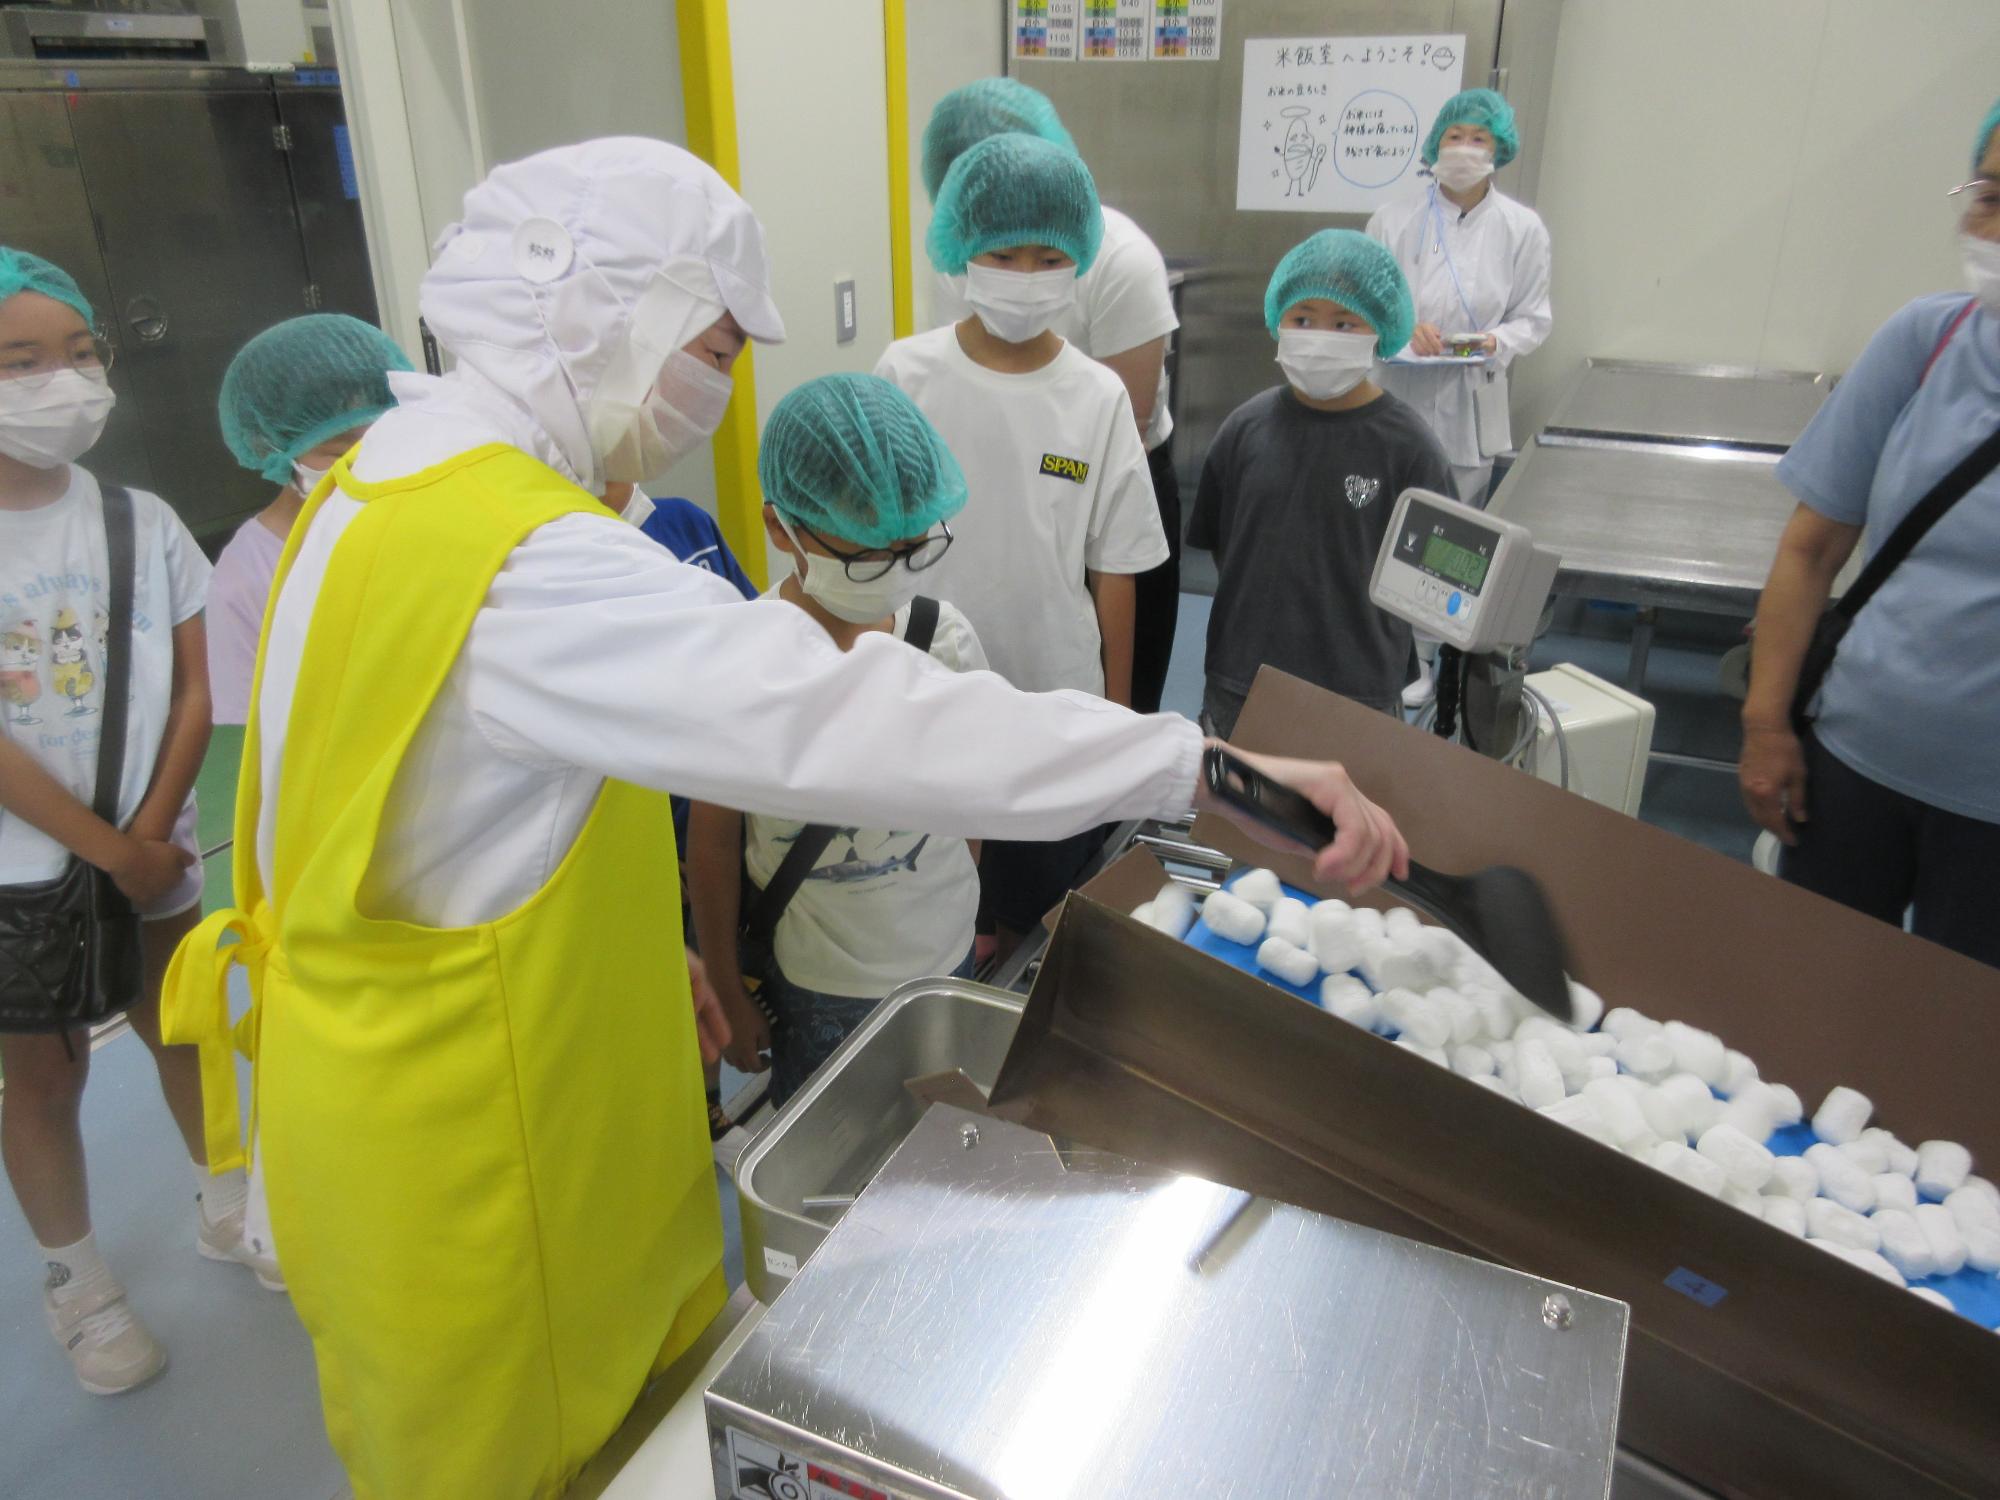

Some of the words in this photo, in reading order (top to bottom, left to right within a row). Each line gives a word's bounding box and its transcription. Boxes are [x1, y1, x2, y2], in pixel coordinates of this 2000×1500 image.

[1043, 454, 1089, 480] SPAM
[24, 574, 102, 598] always
[38, 732, 66, 748] for
